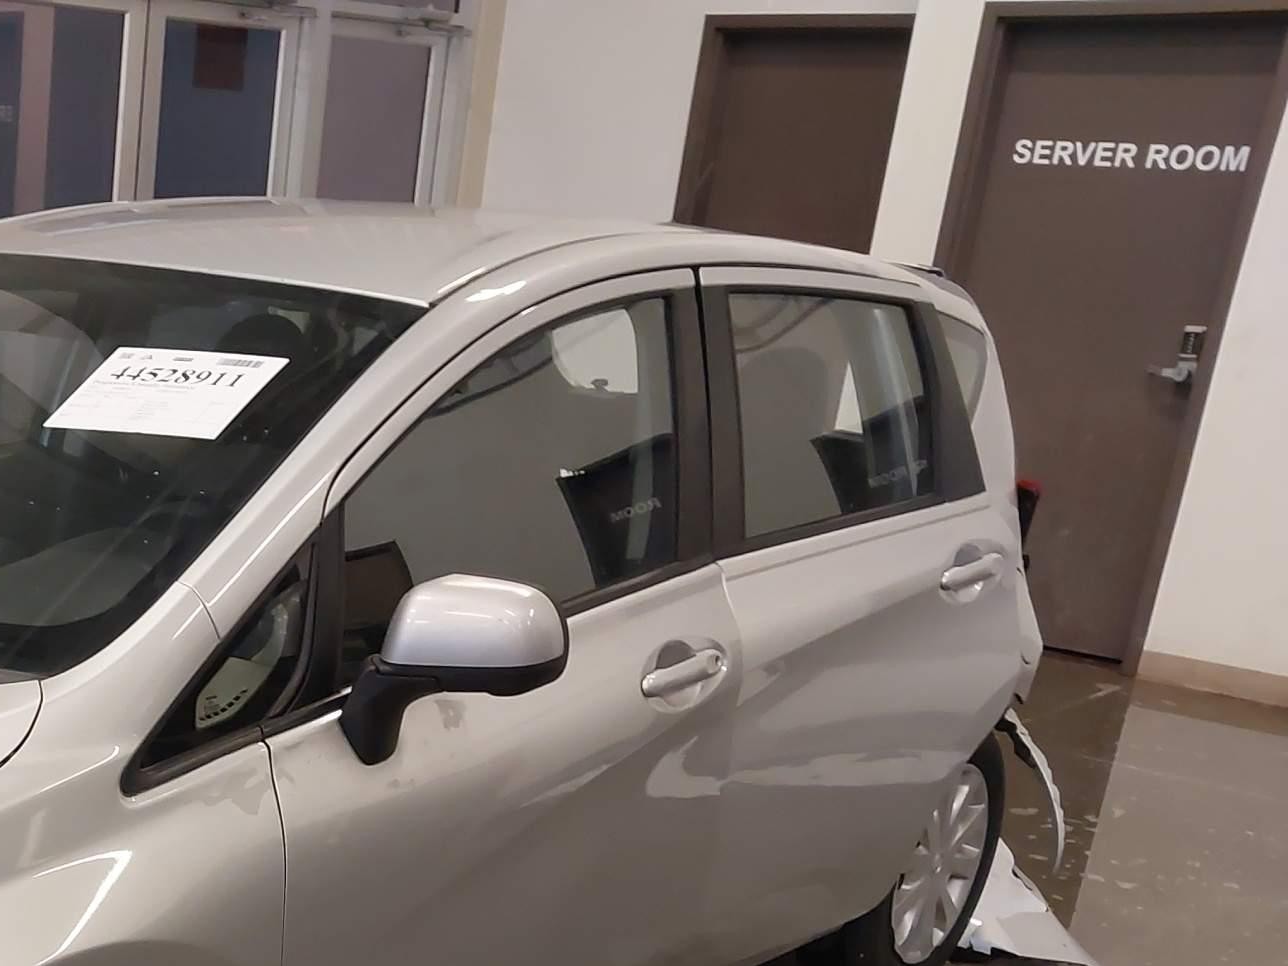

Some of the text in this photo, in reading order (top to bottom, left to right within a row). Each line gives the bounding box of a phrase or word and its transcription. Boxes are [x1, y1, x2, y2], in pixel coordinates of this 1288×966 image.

[1012, 139, 1251, 172] SERVER ROOM
[111, 365, 246, 387] 44528911
